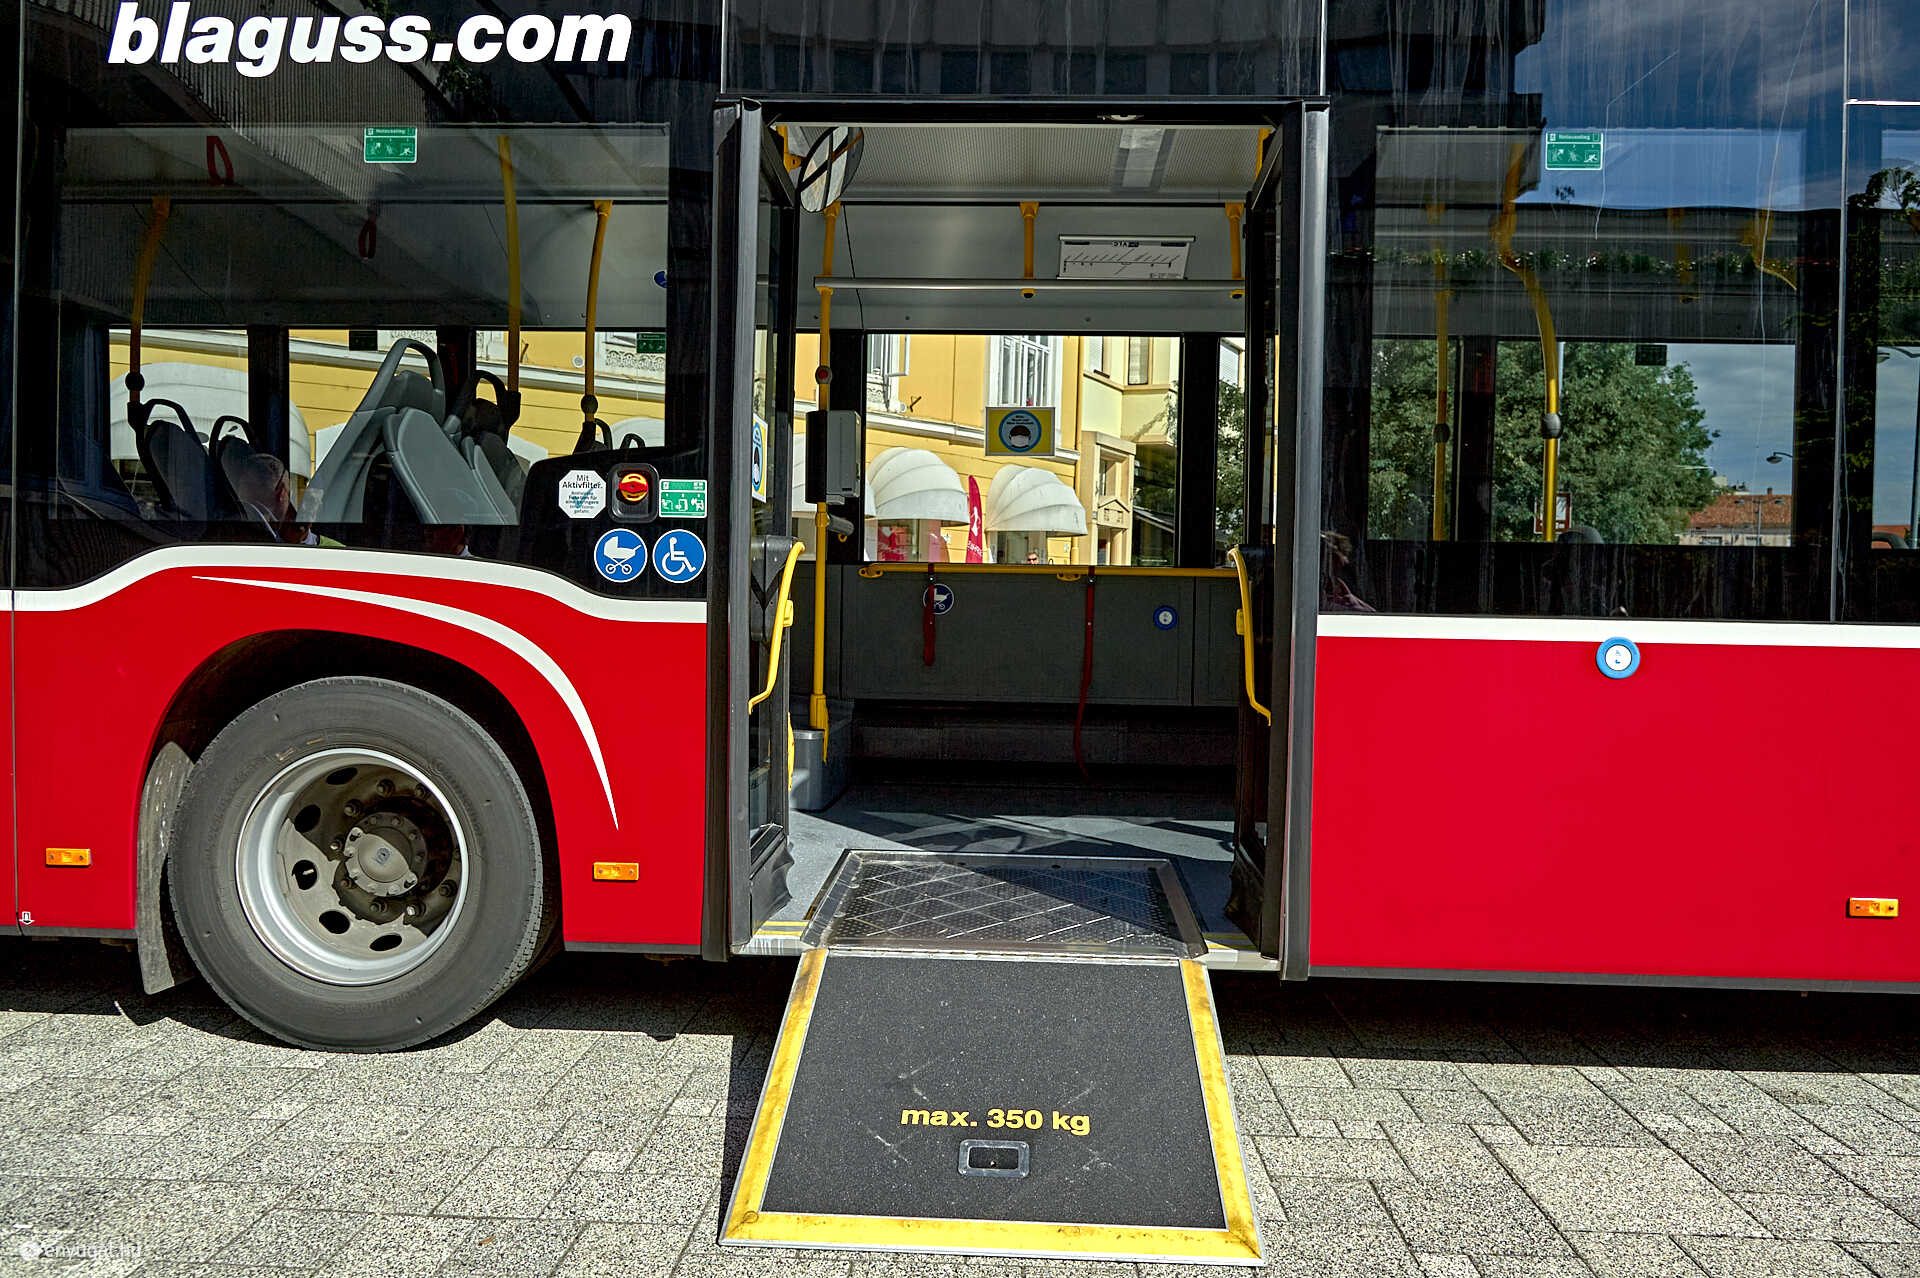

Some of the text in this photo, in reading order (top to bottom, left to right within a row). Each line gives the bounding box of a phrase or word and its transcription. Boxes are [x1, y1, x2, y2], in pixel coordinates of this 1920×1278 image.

[108, 0, 632, 78] blaguss.com
[562, 481, 603, 489] Aktivfilter.
[901, 1108, 1091, 1136] max. 350 kg
